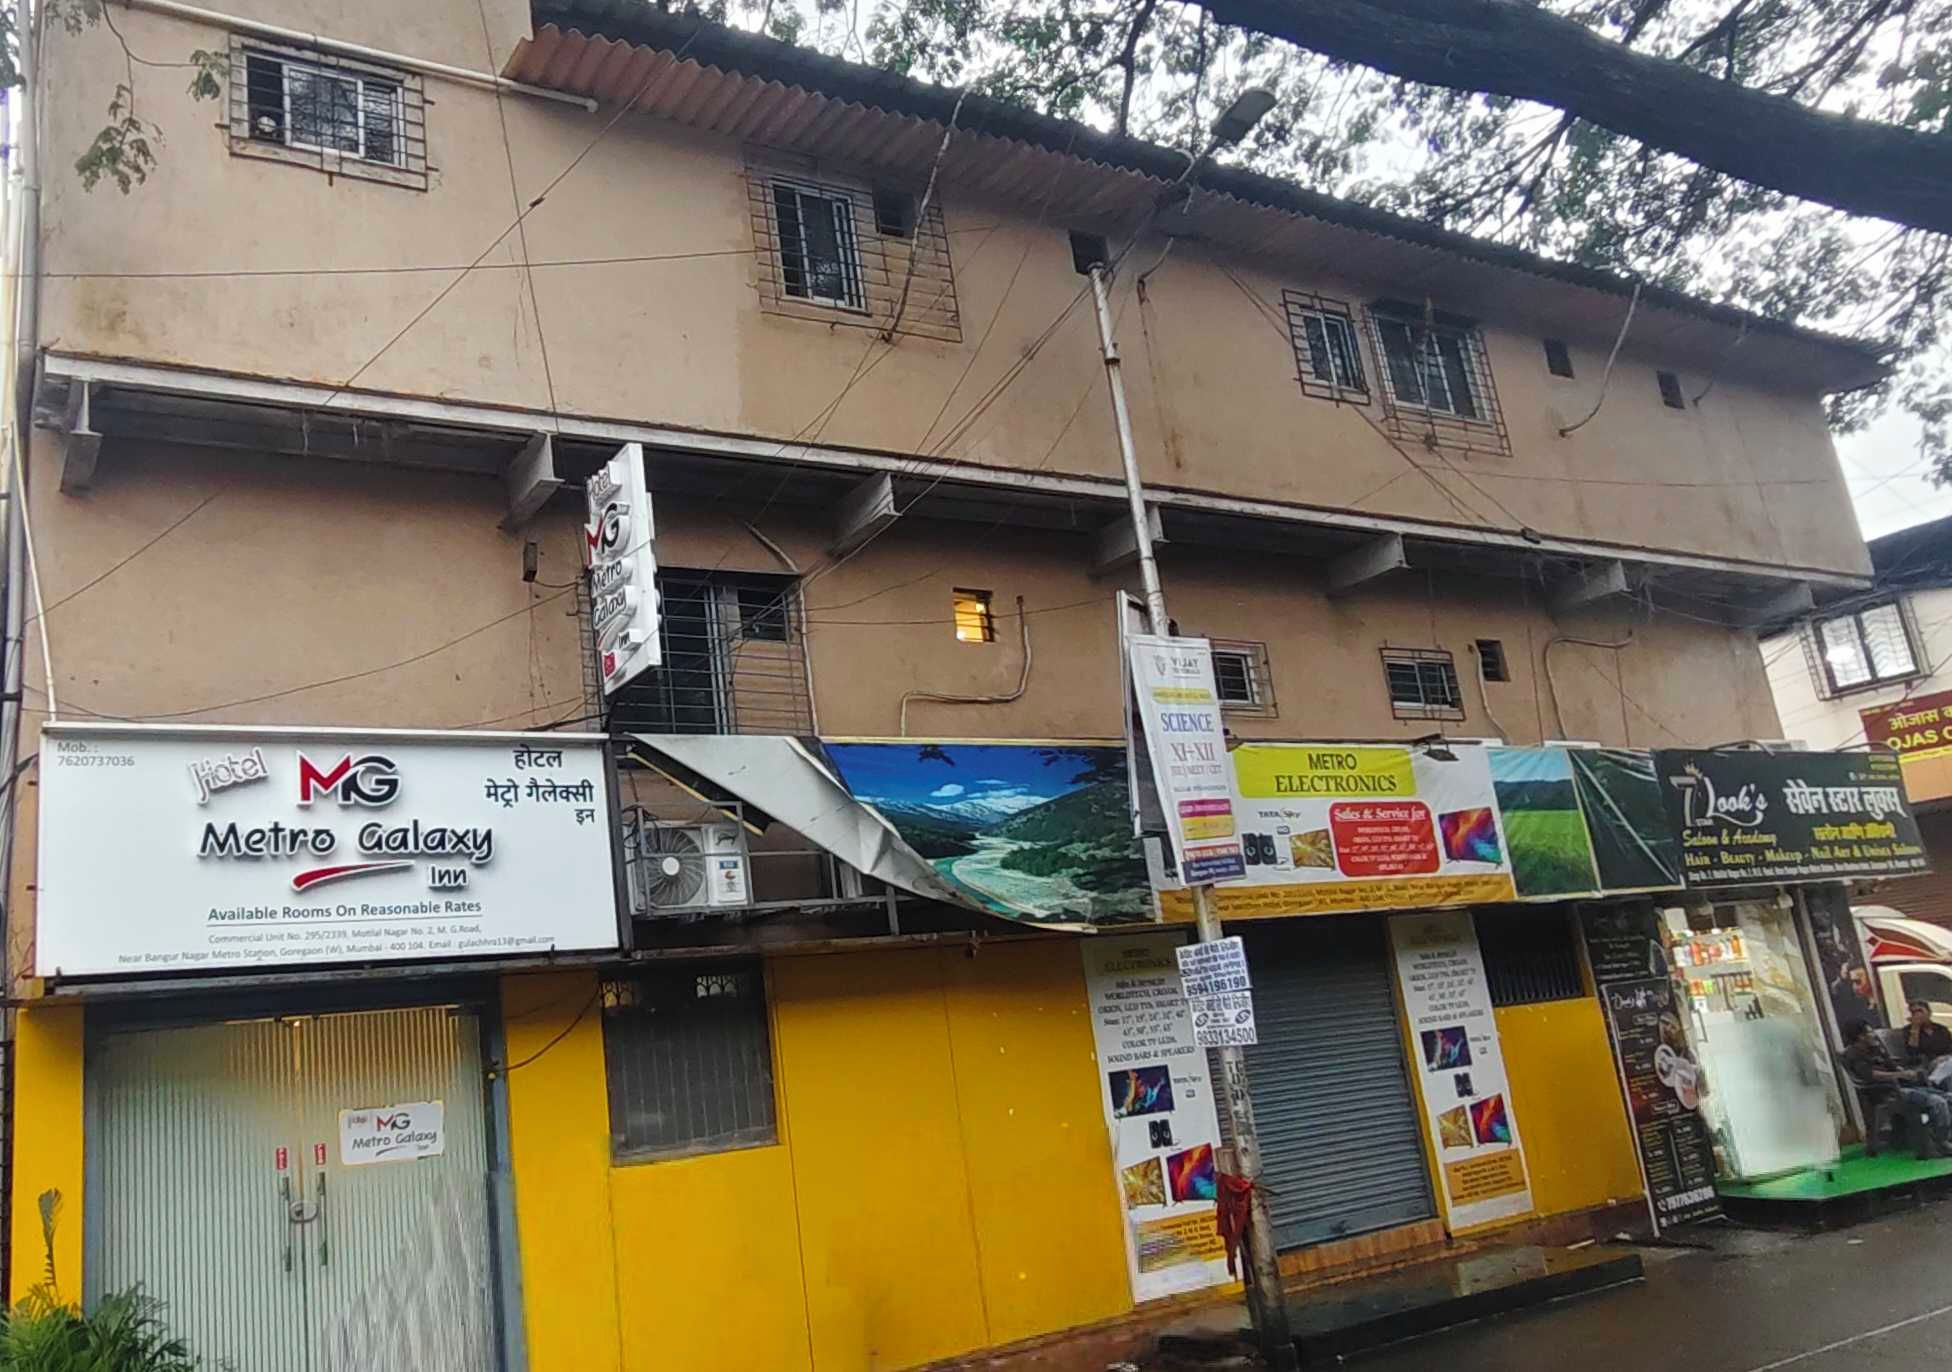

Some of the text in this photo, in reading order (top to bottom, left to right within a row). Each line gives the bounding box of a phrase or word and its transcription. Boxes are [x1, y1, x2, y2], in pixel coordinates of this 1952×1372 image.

[585, 502, 619, 567] MG
[592, 560, 622, 593] Metro
[594, 587, 626, 626] Galaxy
[1170, 655, 1200, 668] VIJAY
[1161, 712, 1215, 733] SCIENCE
[1887, 729, 1939, 751] OJAS
[57, 755, 135, 767] 7620737036
[513, 744, 563, 770] होटल
[1308, 752, 1357, 771] METRO
[192, 748, 268, 803] Hotel
[298, 752, 401, 805] MG
[1275, 773, 1398, 794] ELECTRONICS
[484, 777, 594, 808] मेट्रो गैलेक्सी
[575, 808, 595, 825] इन
[1334, 806, 1360, 820] Sales
[1376, 806, 1409, 820] Service
[200, 818, 494, 863] Metro Galaxy
[430, 866, 468, 886] Inn
[208, 900, 482, 921] Available Rooms On Reasonable Rates
[208, 932, 263, 944] Commercial
[376, 1112, 411, 1132] MG
[351, 1131, 437, 1150] Metro Galaxy
